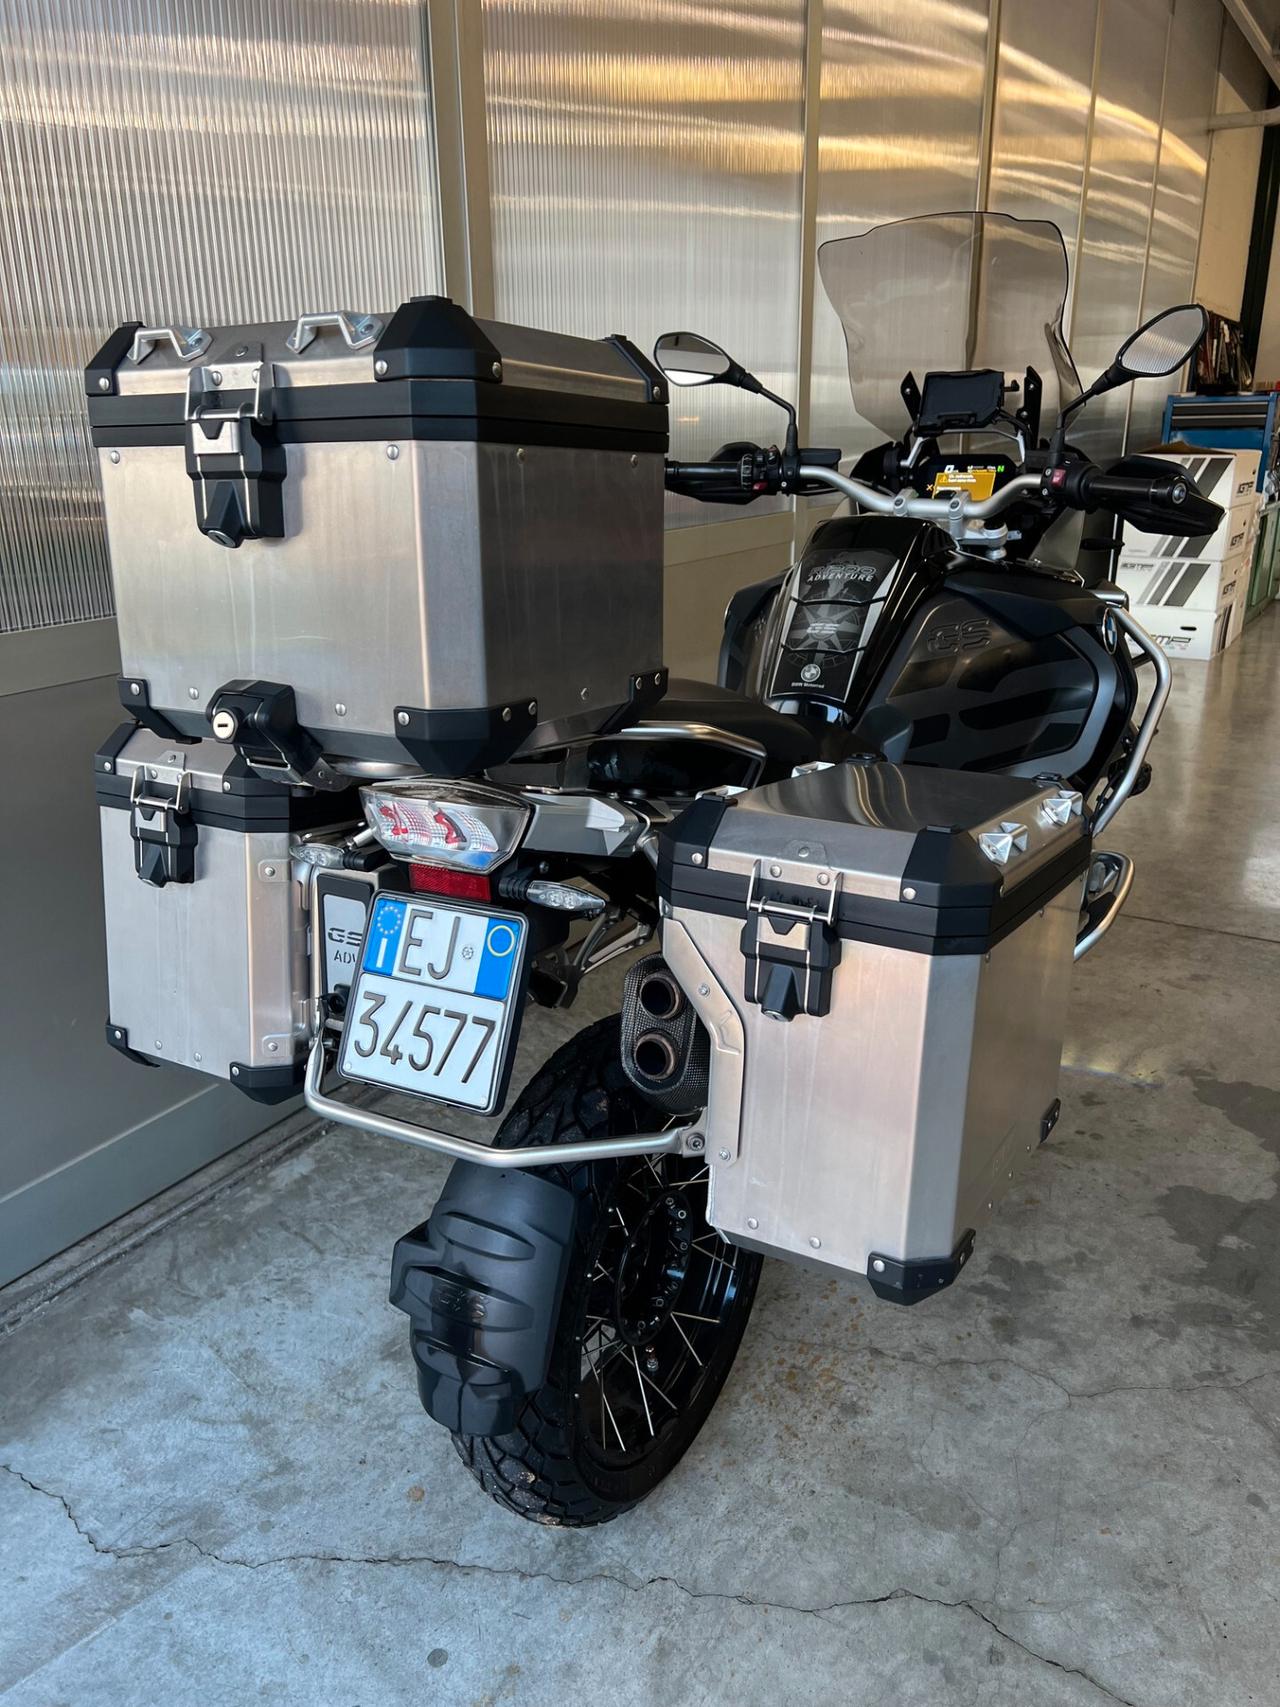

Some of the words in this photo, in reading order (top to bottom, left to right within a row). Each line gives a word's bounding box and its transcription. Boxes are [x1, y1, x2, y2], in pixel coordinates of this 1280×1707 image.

[807, 573, 874, 582] ADVENTURE
[328, 927, 363, 947] GS
[399, 908, 461, 980] EJ
[354, 990, 496, 1084] 34577
